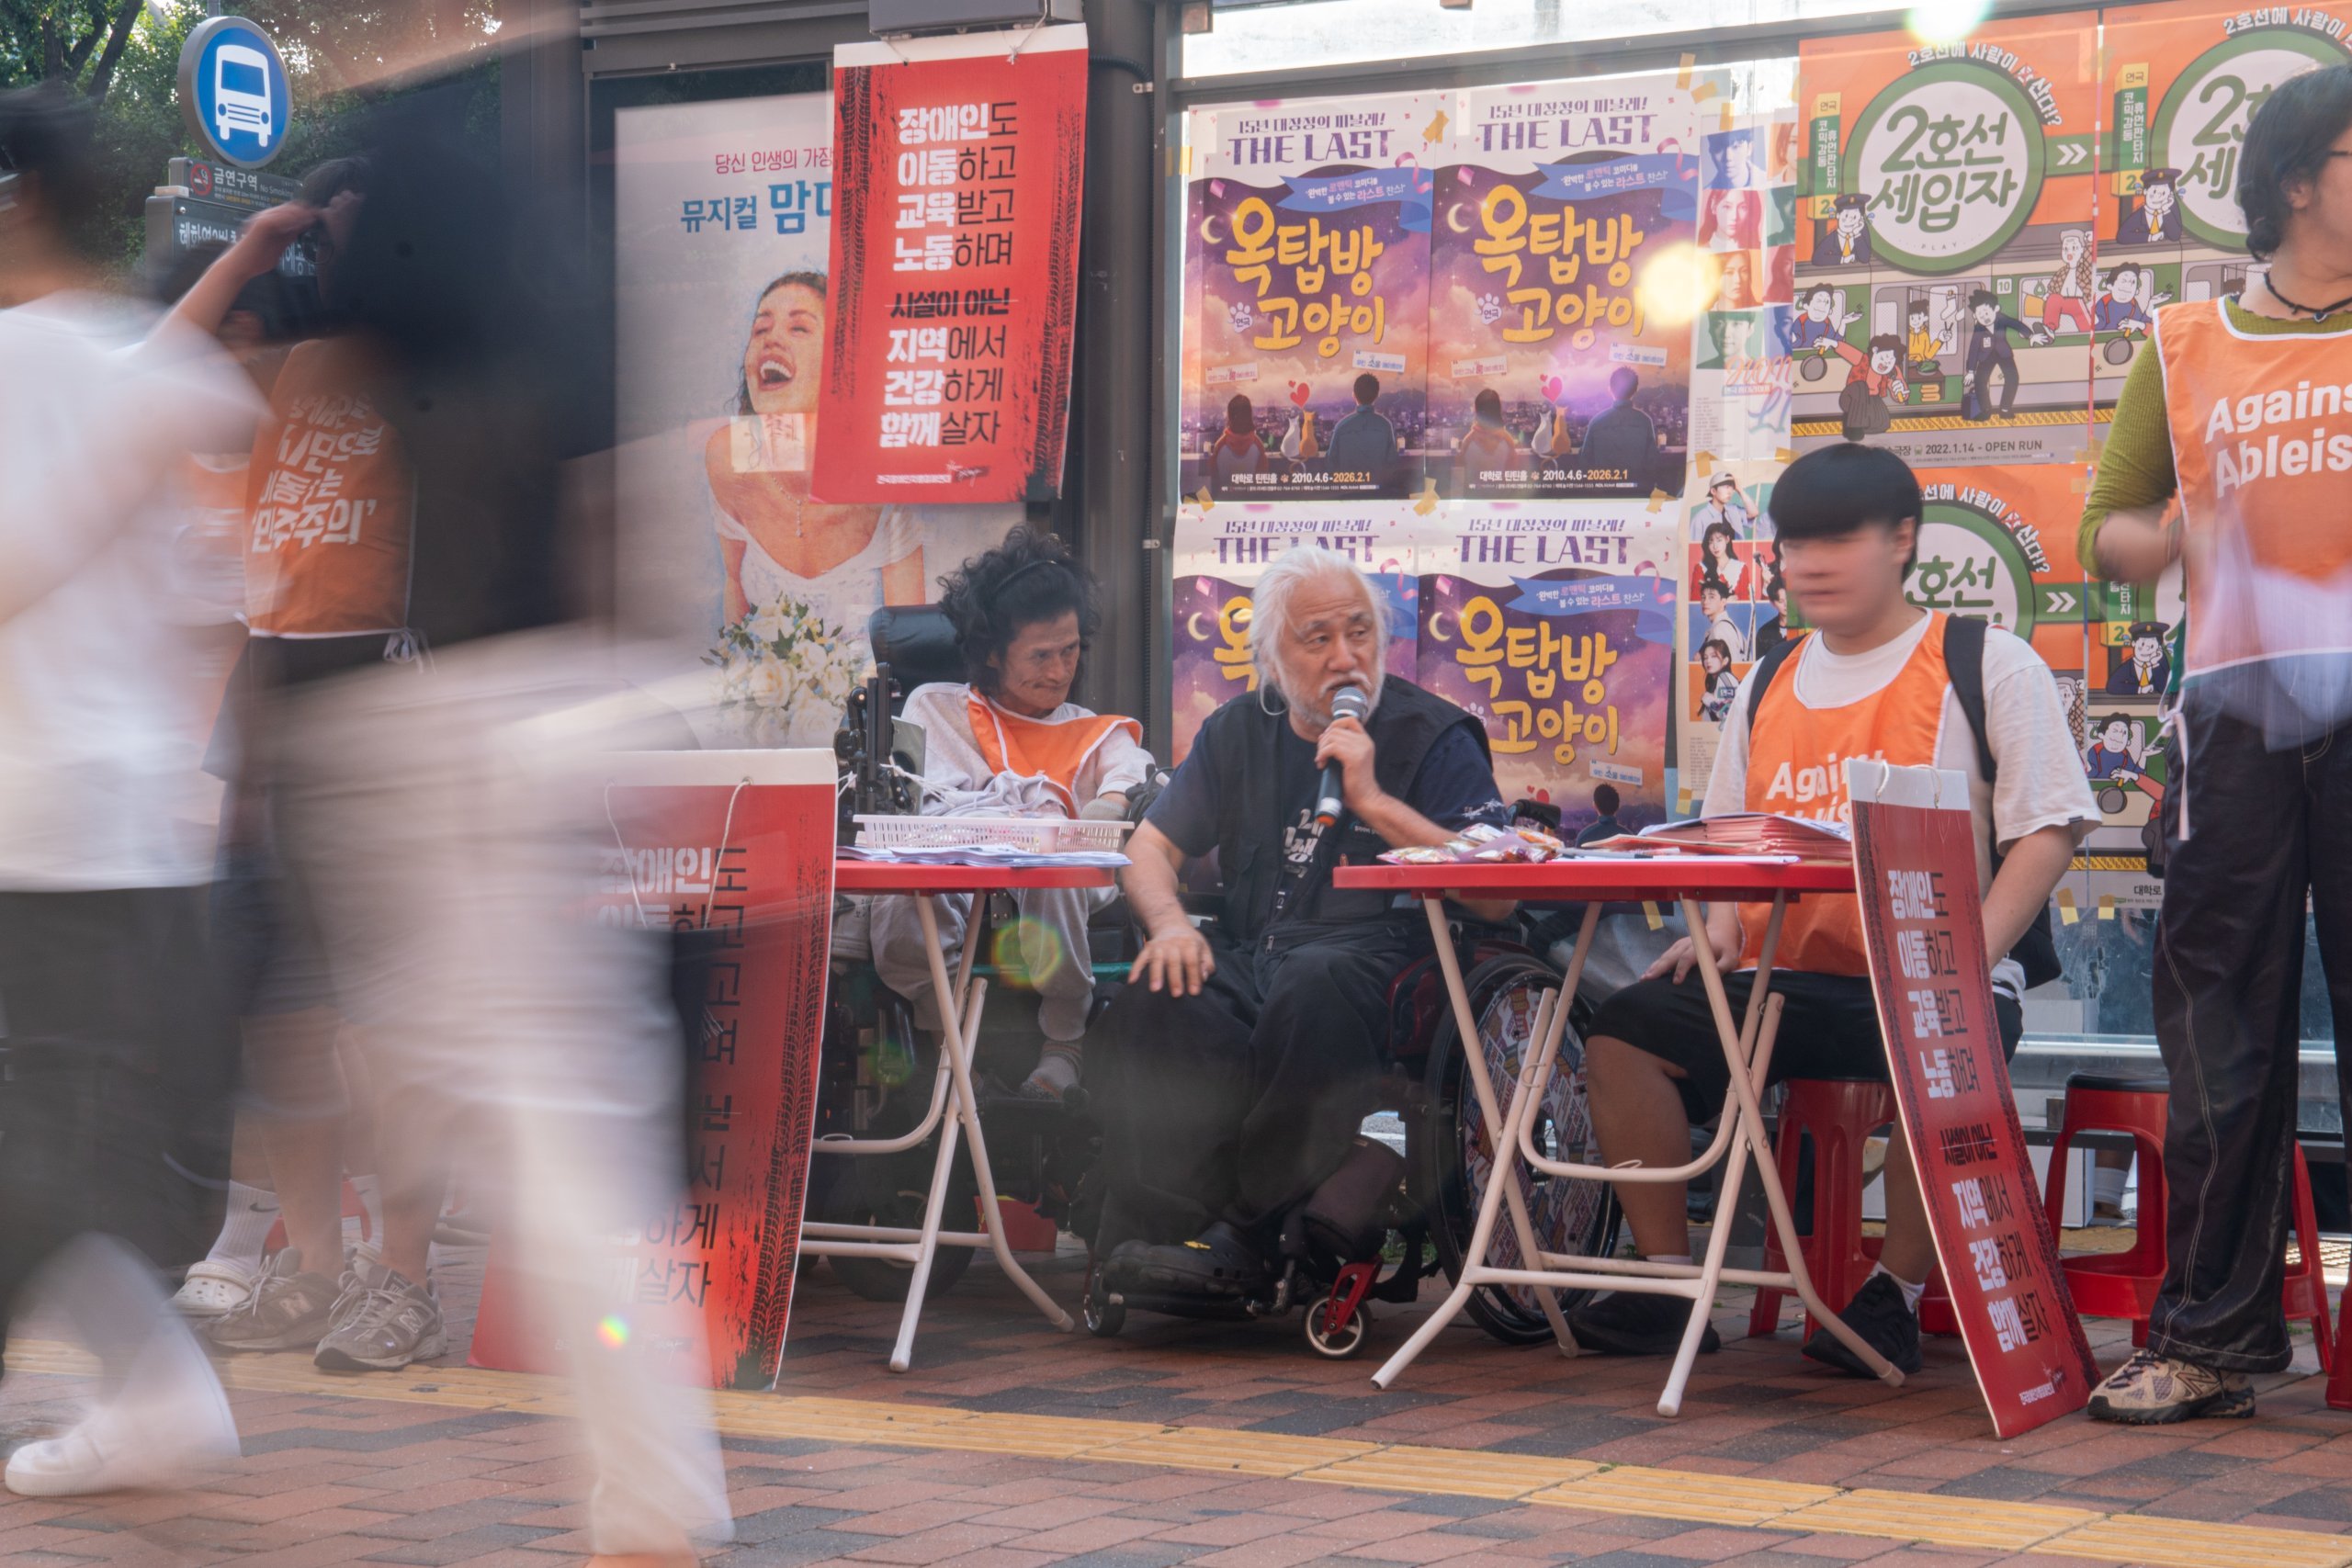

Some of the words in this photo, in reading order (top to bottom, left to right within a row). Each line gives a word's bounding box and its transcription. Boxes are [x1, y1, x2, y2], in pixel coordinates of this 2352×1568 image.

[2223, 7, 2288, 36] 2호선에
[2292, 8, 2346, 38] 사람이
[1970, 42, 2018, 72] 사람이
[899, 101, 1018, 145] 장애인도
[1477, 120, 1549, 152] THE
[1560, 114, 1657, 148] LAST
[1880, 104, 2008, 173] 2호선
[716, 152, 745, 175] 당신
[752, 149, 797, 172] 인생의
[897, 145, 1017, 186] 이동하고
[1227, 135, 1294, 166] THE
[1305, 130, 1395, 162] LAST
[213, 167, 257, 192] 금연구역
[680, 196, 757, 233] 뮤지컬
[1866, 168, 2018, 233] 세입자
[893, 231, 1013, 271] 노동하며
[1226, 197, 1384, 297] 옥탑방
[1474, 185, 1644, 288] 옥탑방
[1253, 294, 1385, 358] 고양이
[1502, 284, 1645, 351] 고양이
[887, 325, 1008, 363] 지역에서
[883, 367, 1004, 406] 건강하게
[1926, 445, 1974, 456] 2022.1.14
[1985, 441, 2016, 452] OPEN
[2018, 440, 2042, 450] RUN
[1959, 486, 2007, 516] 사람이
[1214, 536, 1281, 564] THE
[1456, 535, 1527, 563] THE
[1536, 535, 1634, 564] LAST
[1591, 593, 1622, 607] 라스트
[1456, 596, 1618, 705] 옥탑방
[1489, 700, 1619, 765] 고양이
[1888, 869, 1950, 919] 장애인도
[2134, 885, 2162, 896] 대학로
[1897, 928, 1958, 979] 이동하고
[1920, 1046, 1981, 1100] 노동하며
[1952, 1172, 2015, 1230] 지역에서
[1969, 1230, 2032, 1292] 건강하게
